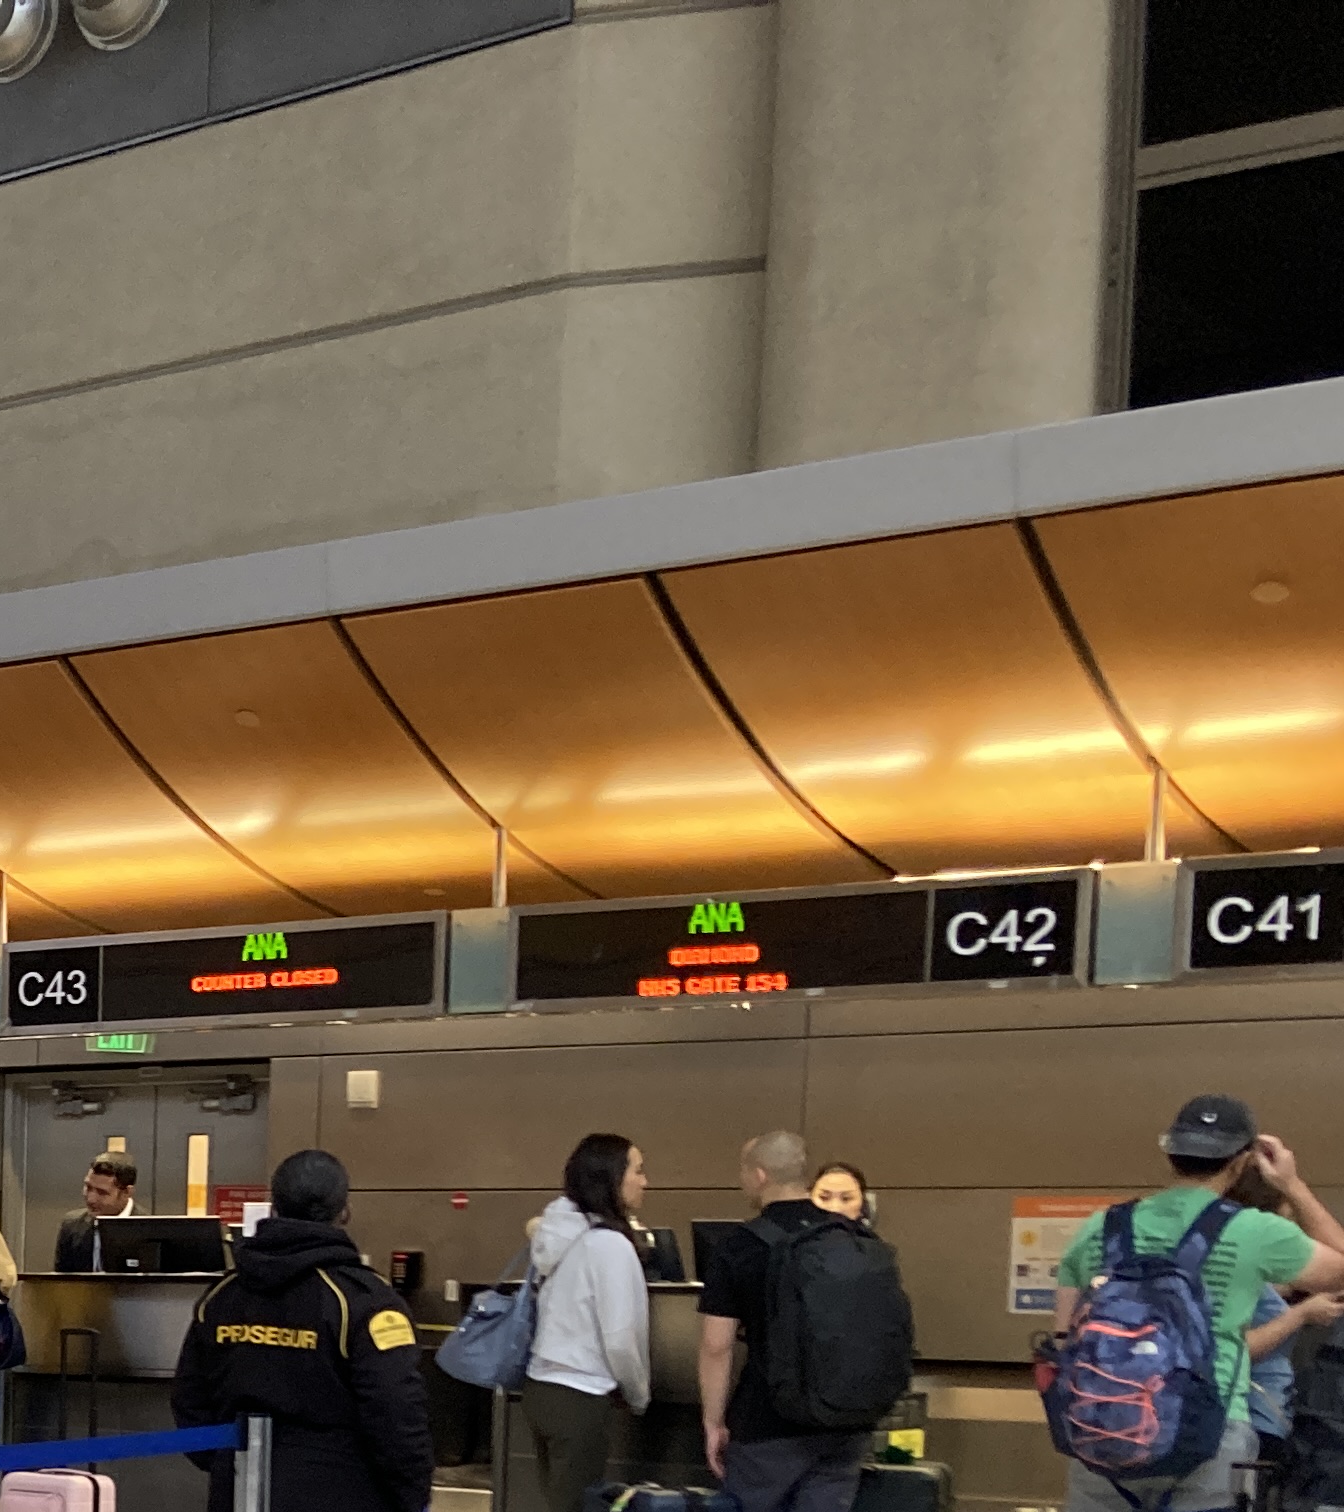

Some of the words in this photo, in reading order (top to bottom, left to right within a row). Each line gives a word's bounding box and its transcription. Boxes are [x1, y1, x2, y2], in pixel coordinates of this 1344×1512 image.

[688, 902, 745, 934] ANA
[947, 907, 1058, 956] C42
[1207, 894, 1322, 944] C41
[242, 932, 288, 961] ANA
[17, 968, 88, 1007] C43
